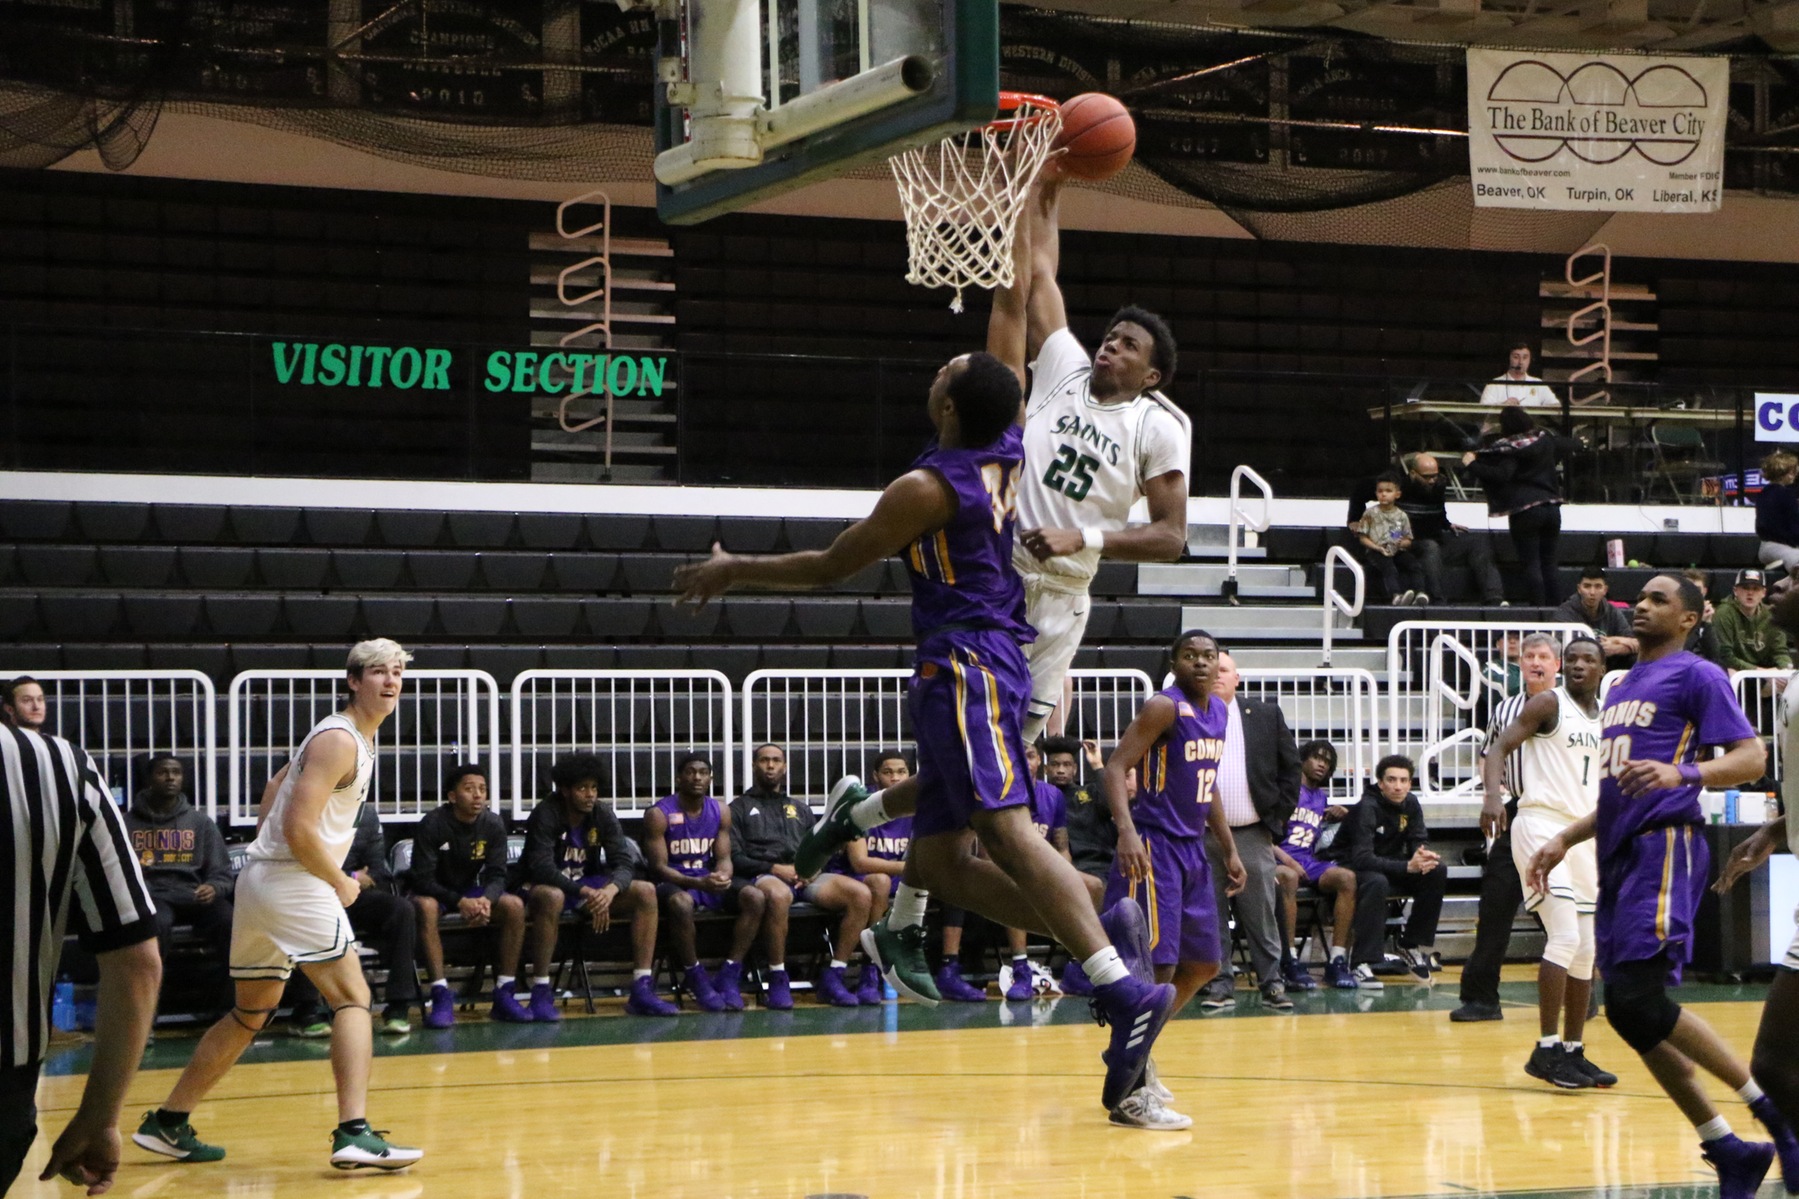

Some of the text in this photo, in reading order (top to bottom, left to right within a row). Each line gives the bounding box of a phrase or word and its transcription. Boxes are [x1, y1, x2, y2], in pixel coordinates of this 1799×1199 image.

[1487, 106, 1706, 136] The Bank of Beaver City
[1477, 166, 1571, 178] www.bankofbeaver.com
[1669, 171, 1697, 181] Member
[1476, 183, 1546, 199] Beaver, OK
[1566, 186, 1634, 203] Turpin, OK
[1652, 190, 1697, 204] Liberal,
[272, 342, 667, 397] VISITOR SECTION
[1050, 415, 1121, 467] SAINTS
[1042, 443, 1100, 503] 25
[1566, 732, 1601, 751] SAIN
[1582, 754, 1590, 787] 1
[1195, 768, 1217, 804] 12
